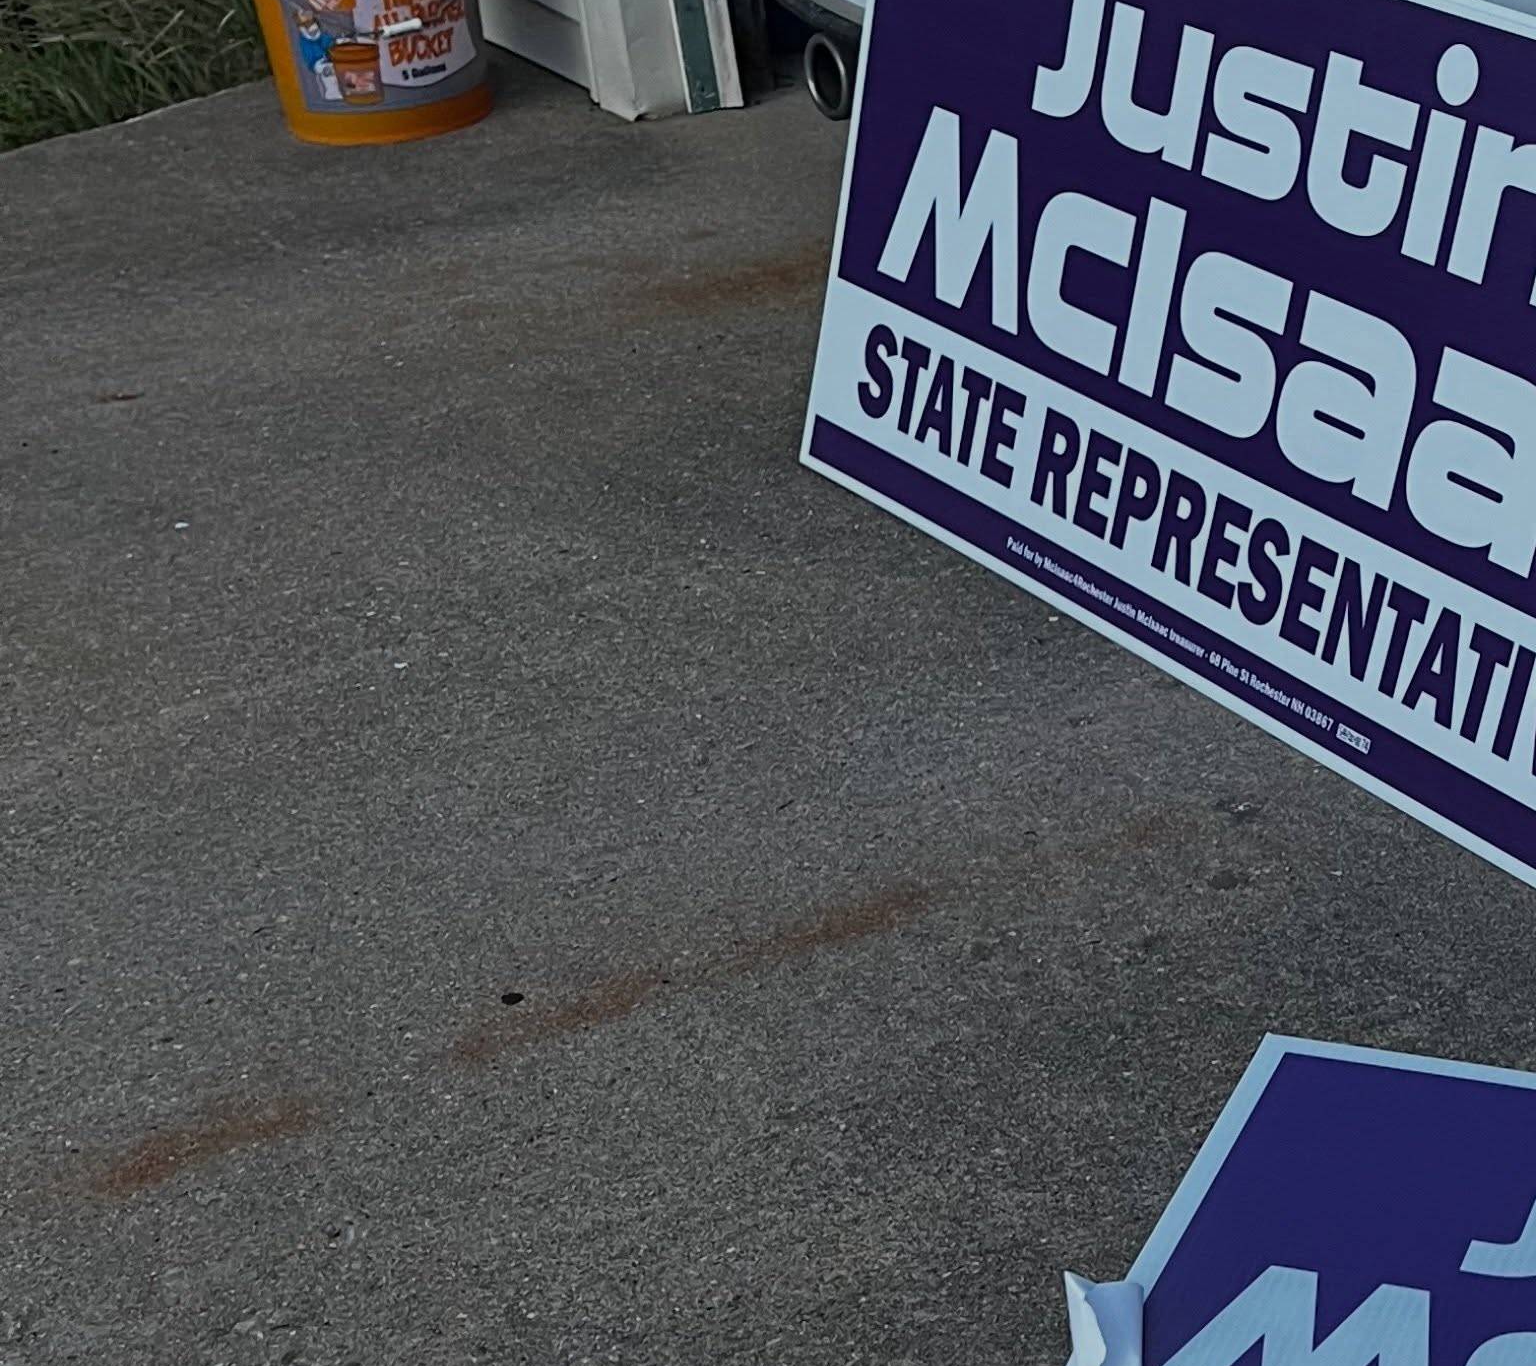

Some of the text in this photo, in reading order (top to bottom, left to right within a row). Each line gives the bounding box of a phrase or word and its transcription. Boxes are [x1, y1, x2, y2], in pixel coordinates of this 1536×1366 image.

[857, 322, 1027, 490] STATE
[1006, 535, 1024, 556] Paid
[1112, 596, 1138, 621] Justin
[1220, 657, 1240, 681] Pine
[1249, 672, 1292, 710] Rochester
[1290, 696, 1305, 717] NH
[1304, 705, 1336, 733] 03867
